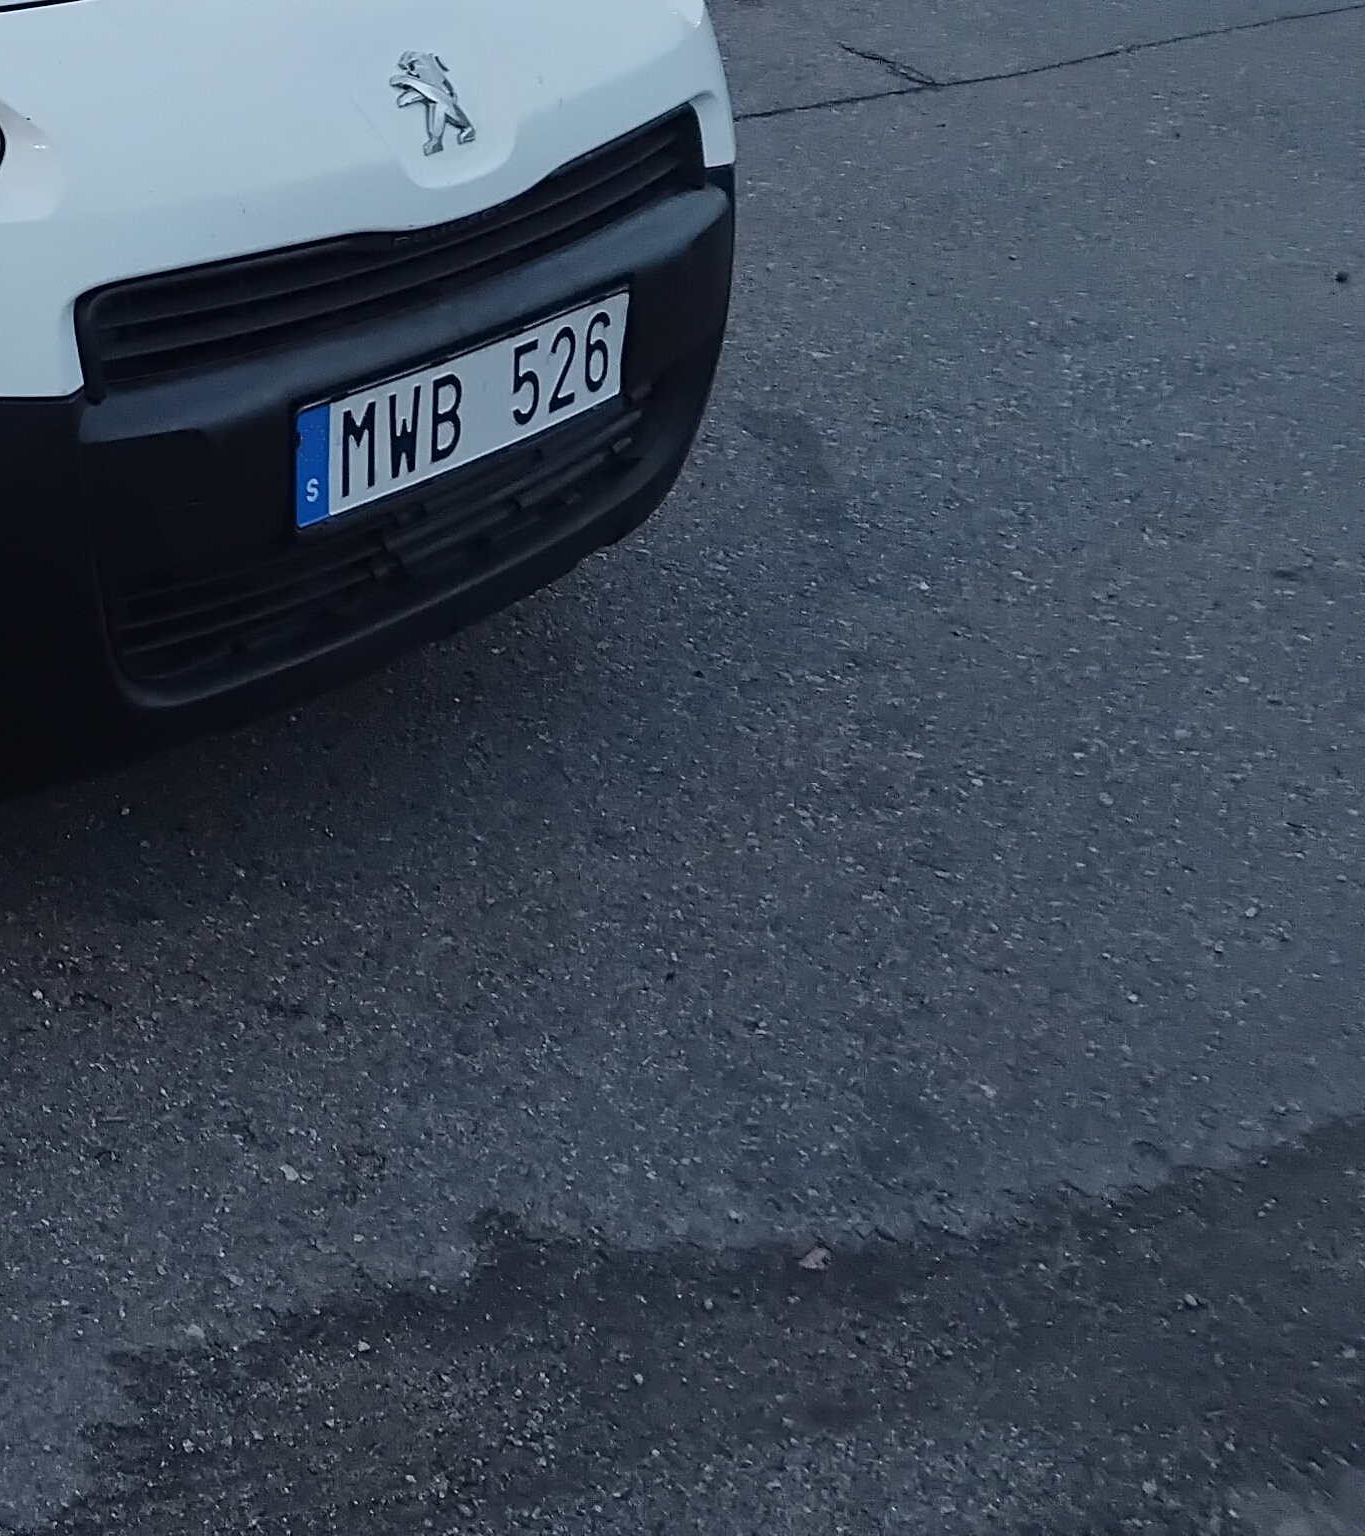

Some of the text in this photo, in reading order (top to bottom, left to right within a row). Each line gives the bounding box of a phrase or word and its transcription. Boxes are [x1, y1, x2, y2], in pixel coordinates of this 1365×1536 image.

[341, 310, 611, 498] MWB 526
[305, 477, 321, 503] S
